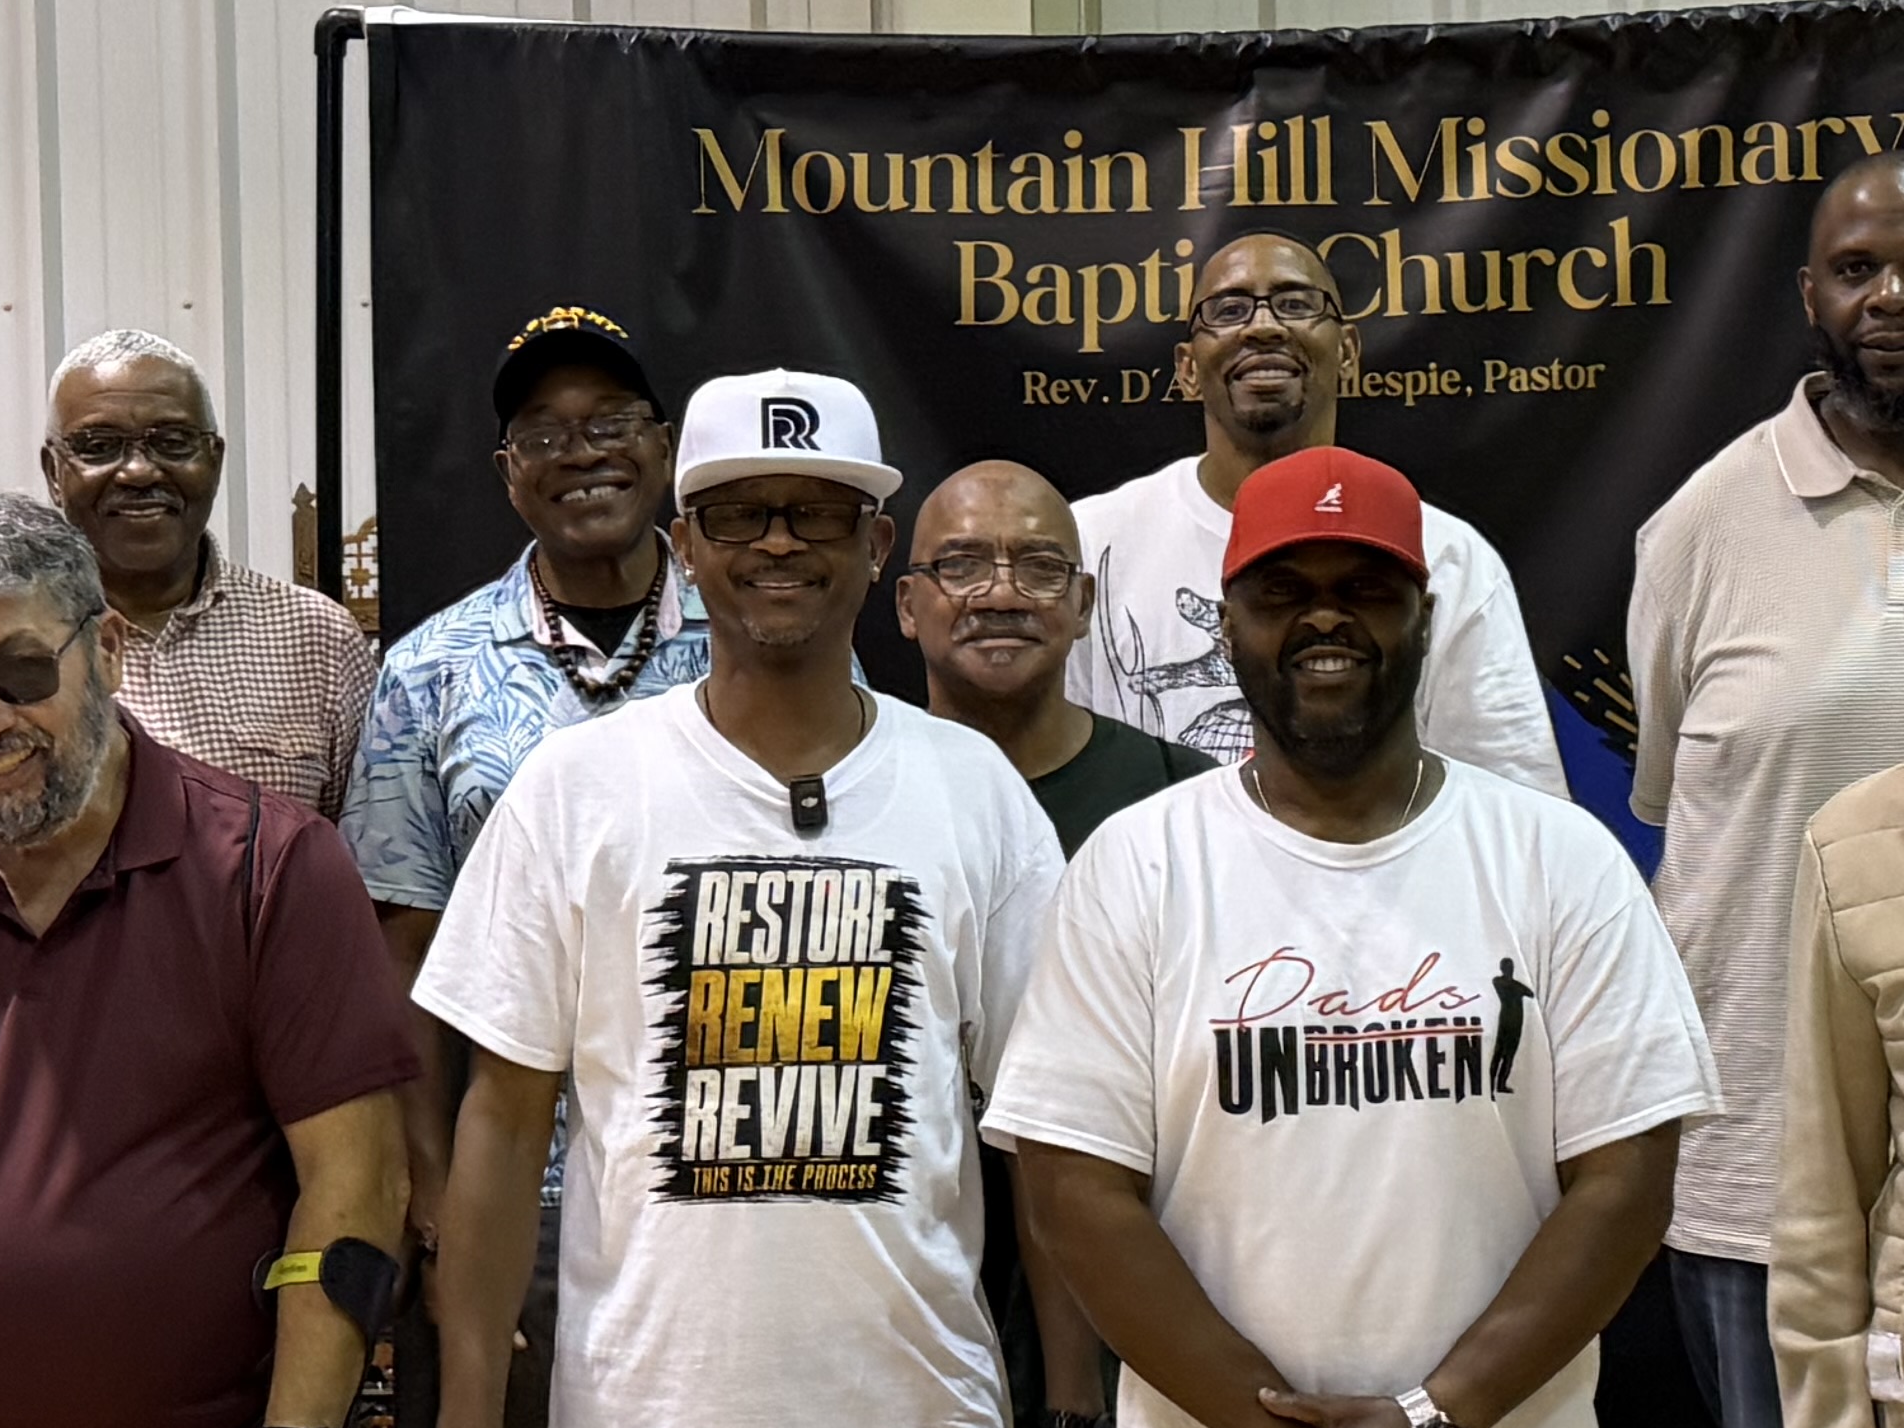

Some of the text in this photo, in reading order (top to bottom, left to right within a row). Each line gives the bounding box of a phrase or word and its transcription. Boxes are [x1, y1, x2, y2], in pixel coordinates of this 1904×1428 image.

[691, 127, 1153, 215] Mountain
[1177, 115, 1339, 212] Hill
[953, 238, 1195, 353] Bapti
[1023, 370, 1110, 404] Rev.
[1483, 357, 1606, 393] Pastor
[691, 868, 900, 966] RESTORE
[684, 966, 893, 1067] RENEW
[1208, 946, 1482, 1032] Dads
[681, 1063, 888, 1162] REVIVE
[1213, 1016, 1484, 1125] UNBROKEN
[693, 1163, 878, 1196] THIS IS THE PROCESS
